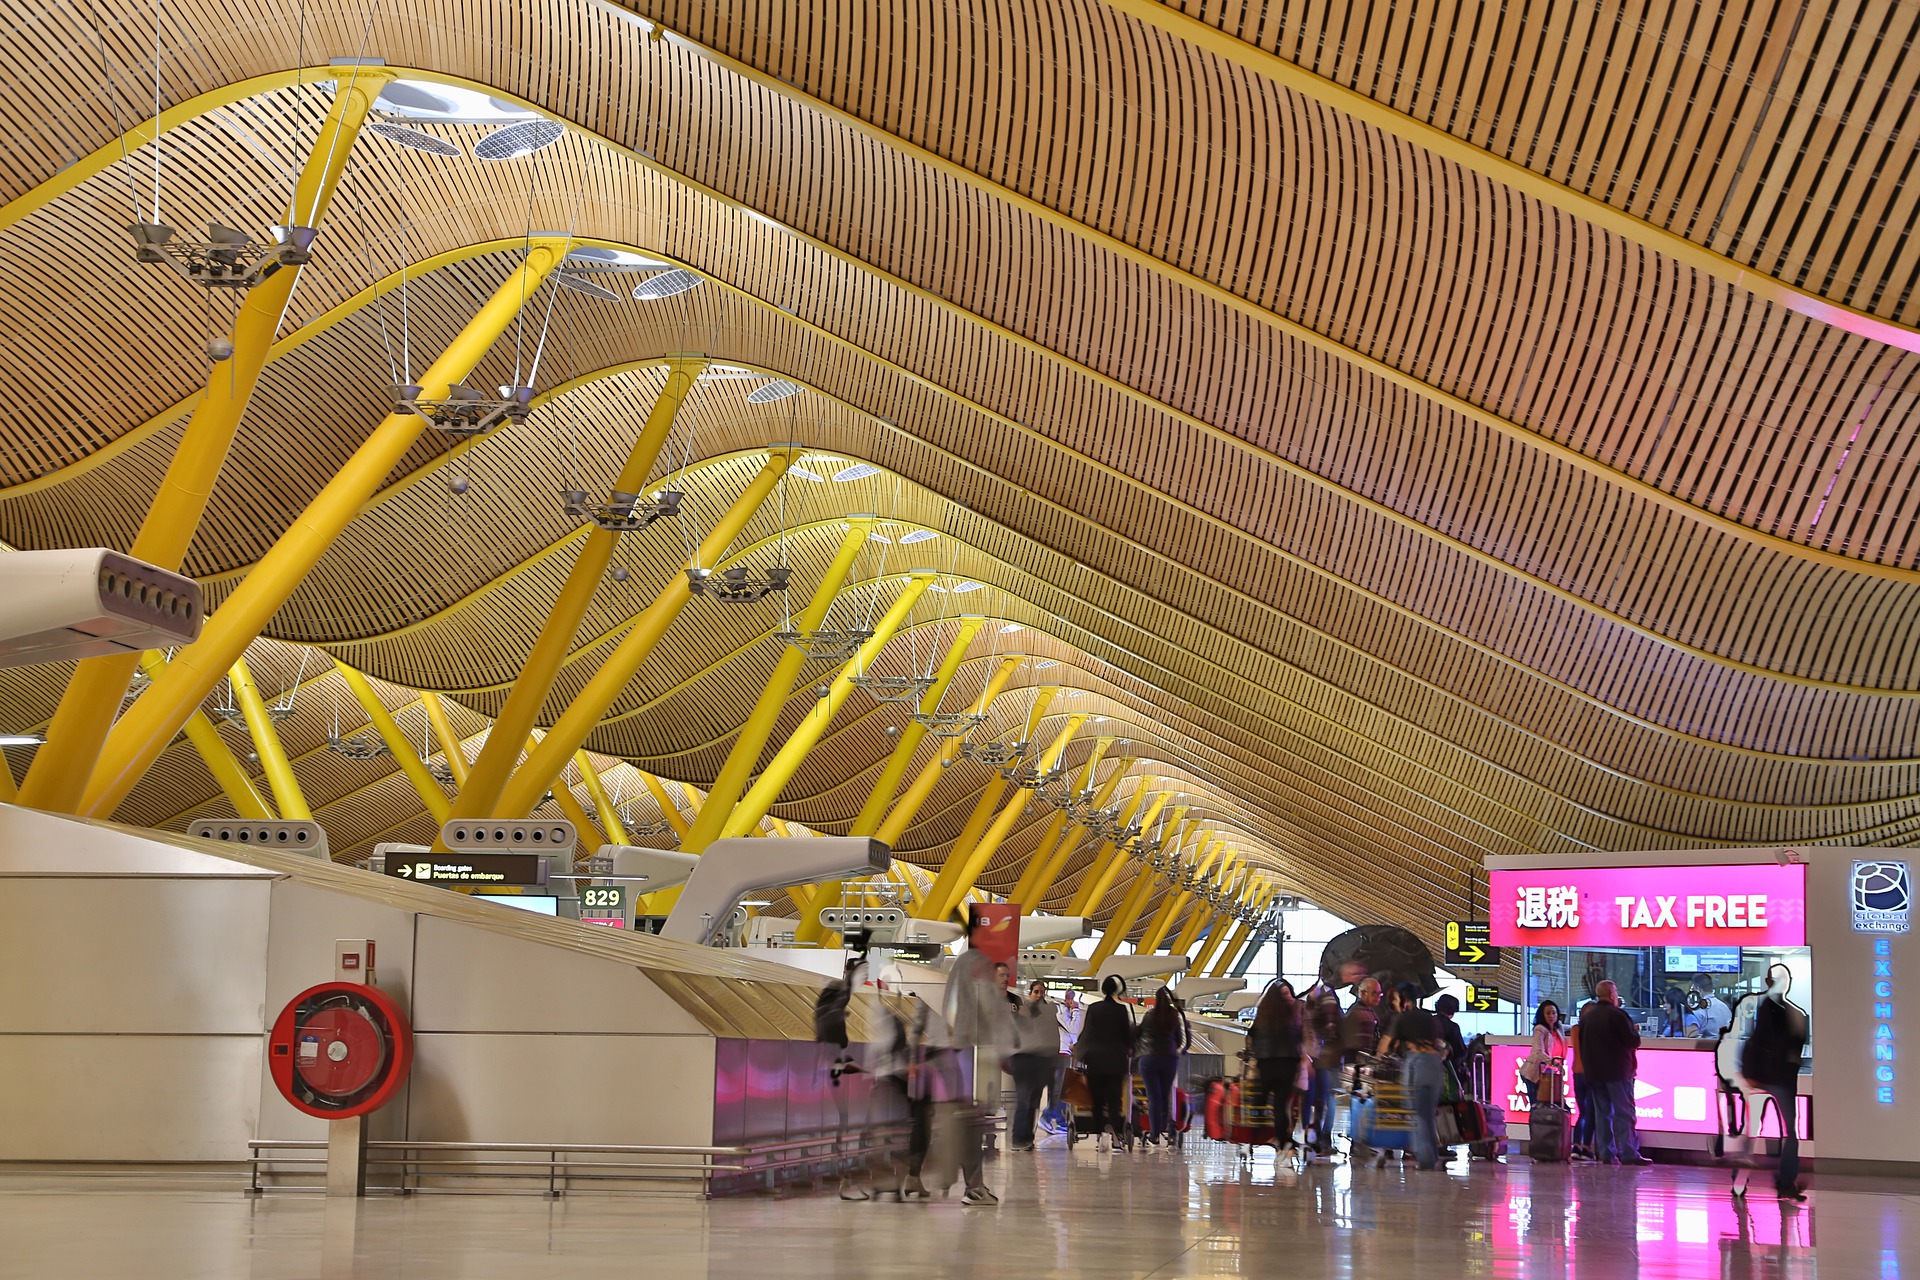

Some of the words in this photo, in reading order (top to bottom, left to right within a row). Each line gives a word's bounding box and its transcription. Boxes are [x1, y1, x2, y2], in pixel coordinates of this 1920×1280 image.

[433, 864, 456, 873] Boarding
[457, 865, 473, 873] gates
[433, 871, 459, 880] Puertas
[460, 872, 469, 880] de
[470, 872, 504, 881] embarque
[585, 889, 620, 906] 829
[1516, 885, 1579, 928] 退税
[1615, 896, 1678, 928] TAX
[1687, 894, 1768, 928] FREE
[1855, 912, 1908, 921] global
[1855, 921, 1909, 932] exchange
[1874, 939, 1894, 1103] EXCHANGE
